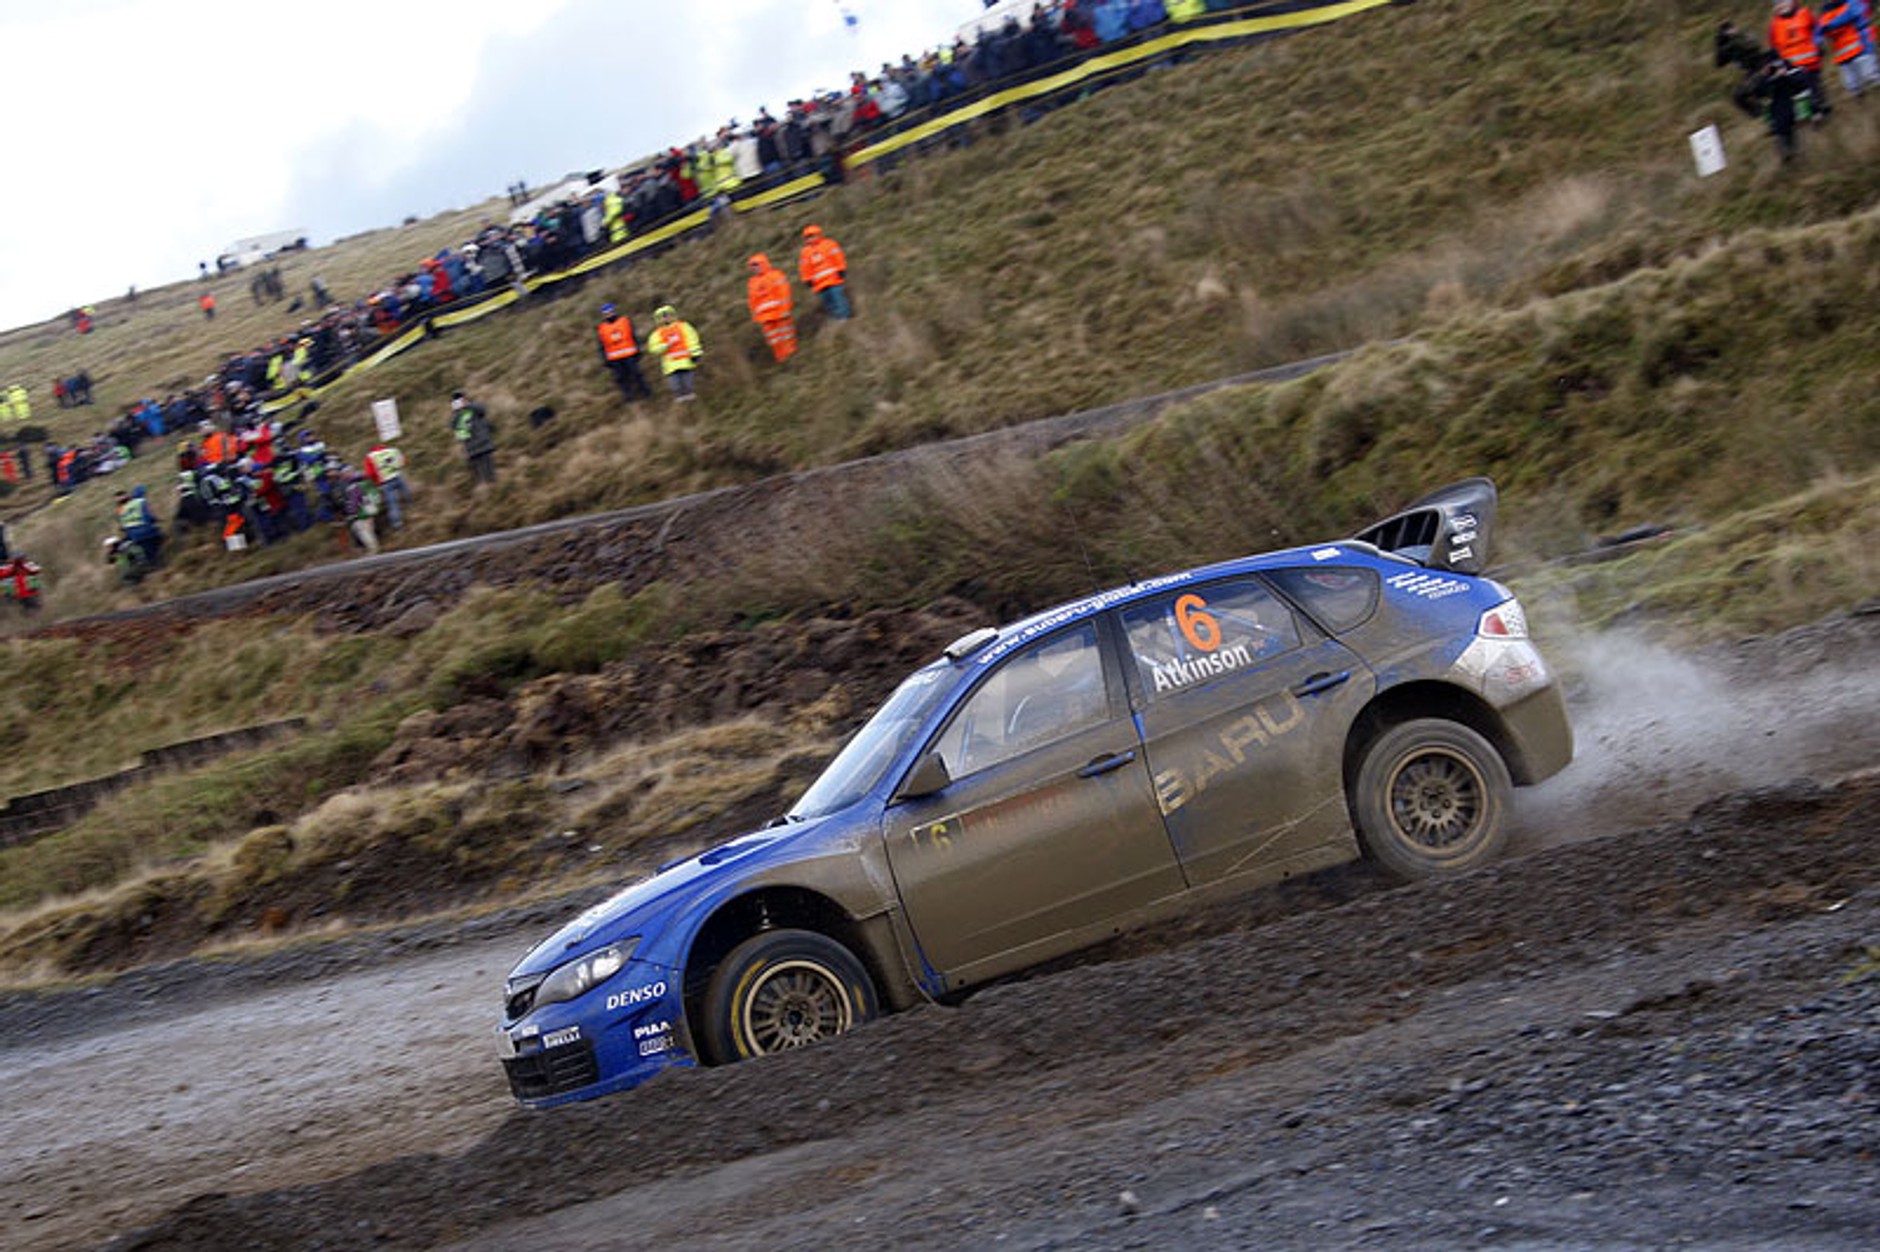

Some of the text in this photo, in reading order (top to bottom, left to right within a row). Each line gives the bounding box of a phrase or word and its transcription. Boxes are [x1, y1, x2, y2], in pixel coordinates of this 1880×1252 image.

[1174, 593, 1222, 653] 6
[1152, 645, 1252, 692] Atkinson
[606, 981, 667, 1011] DENSO
